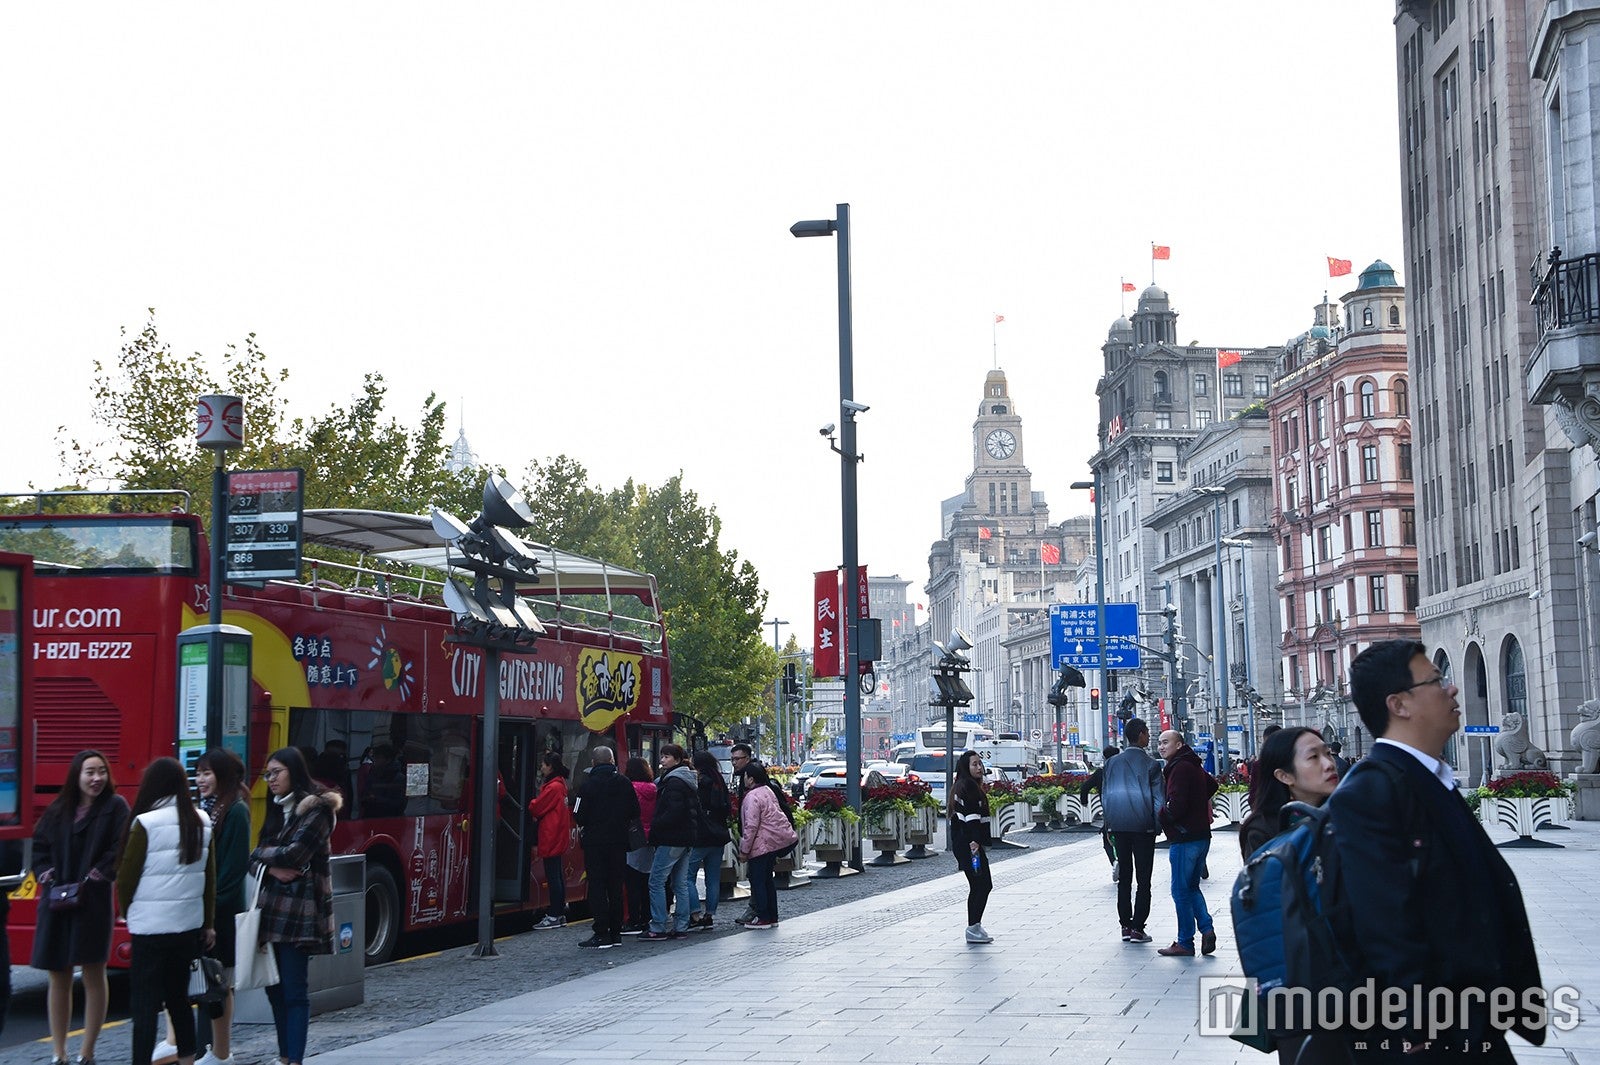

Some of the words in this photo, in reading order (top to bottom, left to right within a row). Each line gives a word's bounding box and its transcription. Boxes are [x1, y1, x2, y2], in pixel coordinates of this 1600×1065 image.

[239, 496, 253, 507] 37
[234, 524, 254, 535] 307
[269, 523, 289, 534] 330
[233, 552, 254, 563] 868
[859, 574, 868, 619] 人民有信
[33, 607, 121, 628] ur.com
[817, 597, 835, 650] 民主
[1060, 610, 1096, 619] 南浦大桥
[1064, 627, 1096, 636] 福州路
[32, 642, 133, 660] 1-820-6222
[293, 636, 331, 658] 各站点
[307, 665, 357, 686] 随意上下
[451, 648, 481, 698] CITY
[500, 660, 564, 703] GHTSEEING
